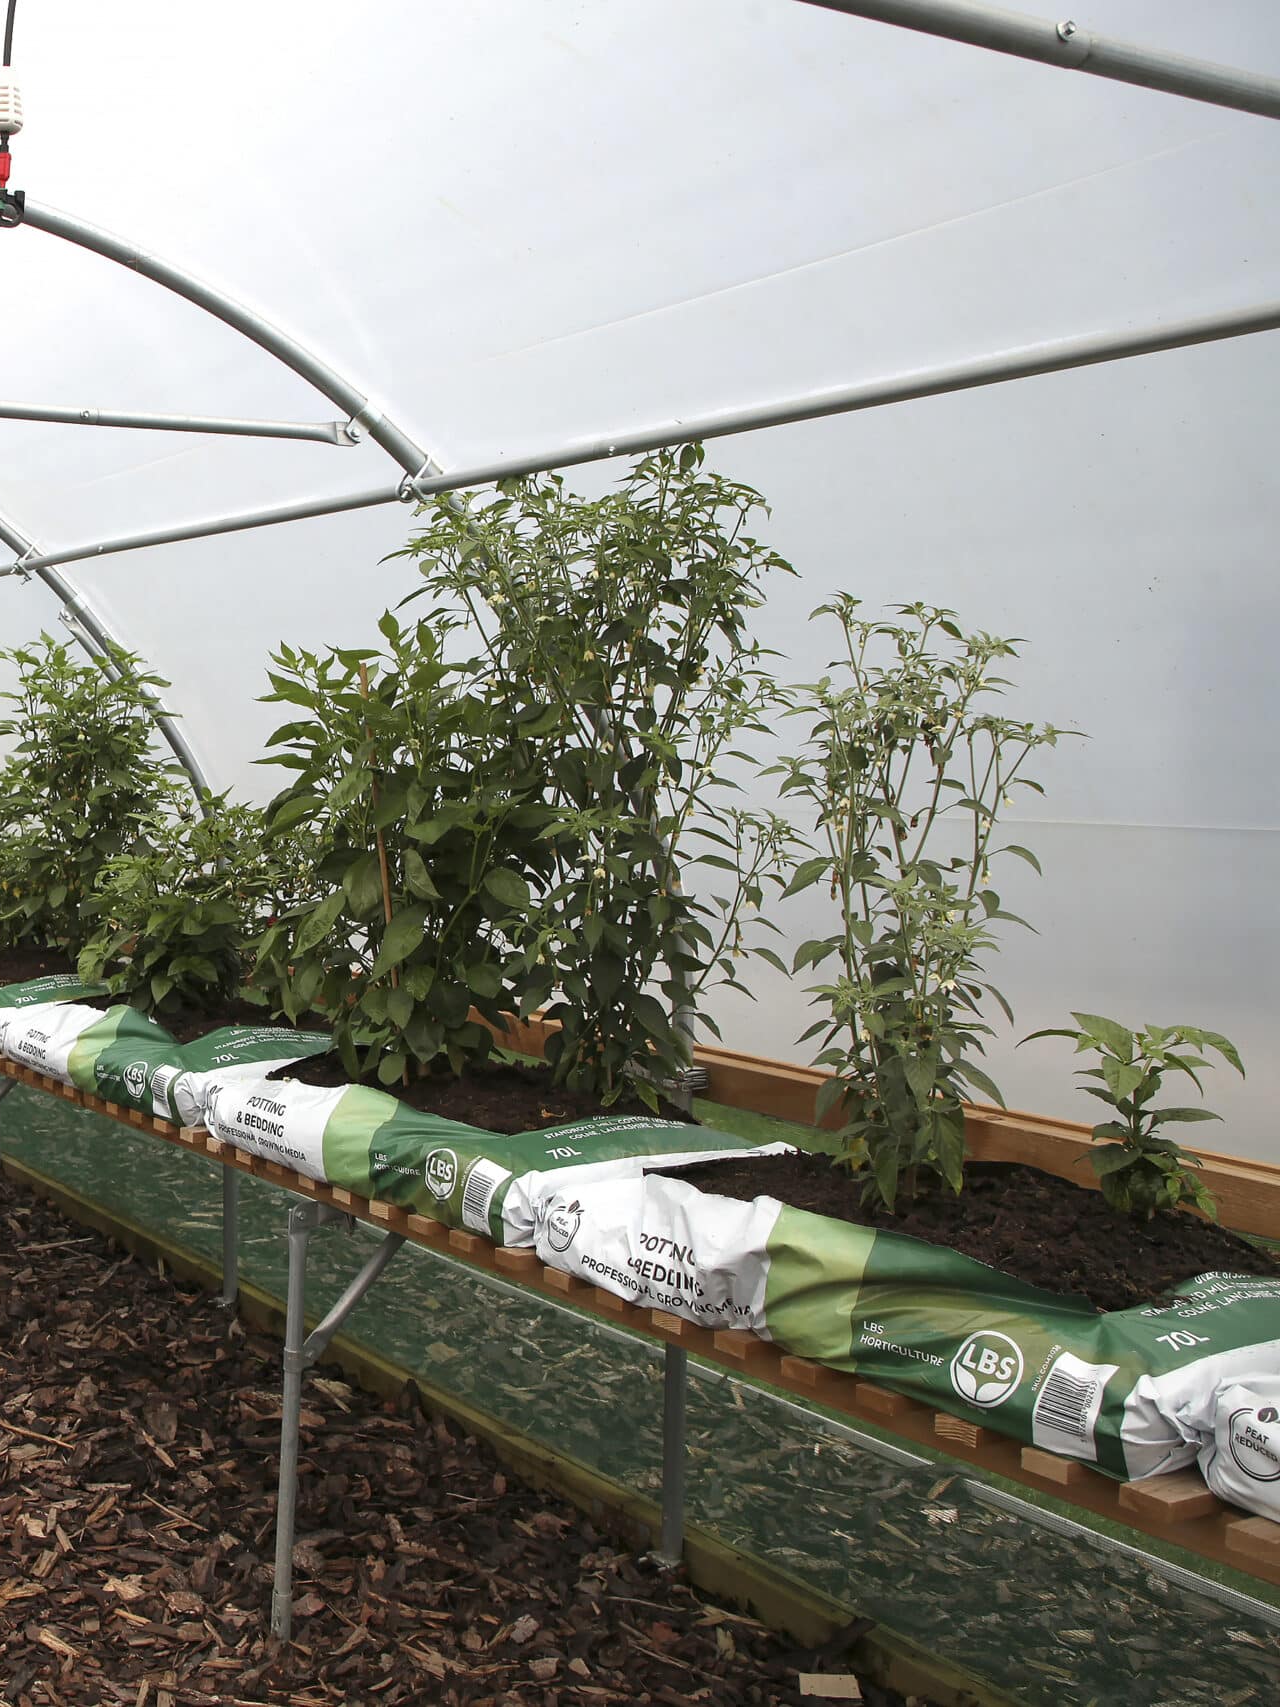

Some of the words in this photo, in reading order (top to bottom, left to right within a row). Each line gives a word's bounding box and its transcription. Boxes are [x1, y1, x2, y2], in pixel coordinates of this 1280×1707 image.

[23, 1041, 46, 1060] BEDDING
[211, 1053, 239, 1064] 70L
[126, 1065, 144, 1082] LBS
[247, 1096, 286, 1117] POTTING
[236, 1111, 242, 1123] &
[244, 1113, 284, 1138] BEDDING
[285, 1147, 307, 1161] MEDIA
[374, 1153, 387, 1162] LBS
[546, 1146, 582, 1160] 70L
[429, 1157, 453, 1181] LBS
[1178, 1301, 1221, 1318] COLNE,
[863, 1320, 885, 1335] LBS
[859, 1333, 945, 1368] HORTICULTURE
[1155, 1330, 1211, 1352] 70L
[962, 1343, 1016, 1381] LBS
[1245, 1425, 1270, 1445] PEAT
[1234, 1433, 1279, 1462] REDUCED
